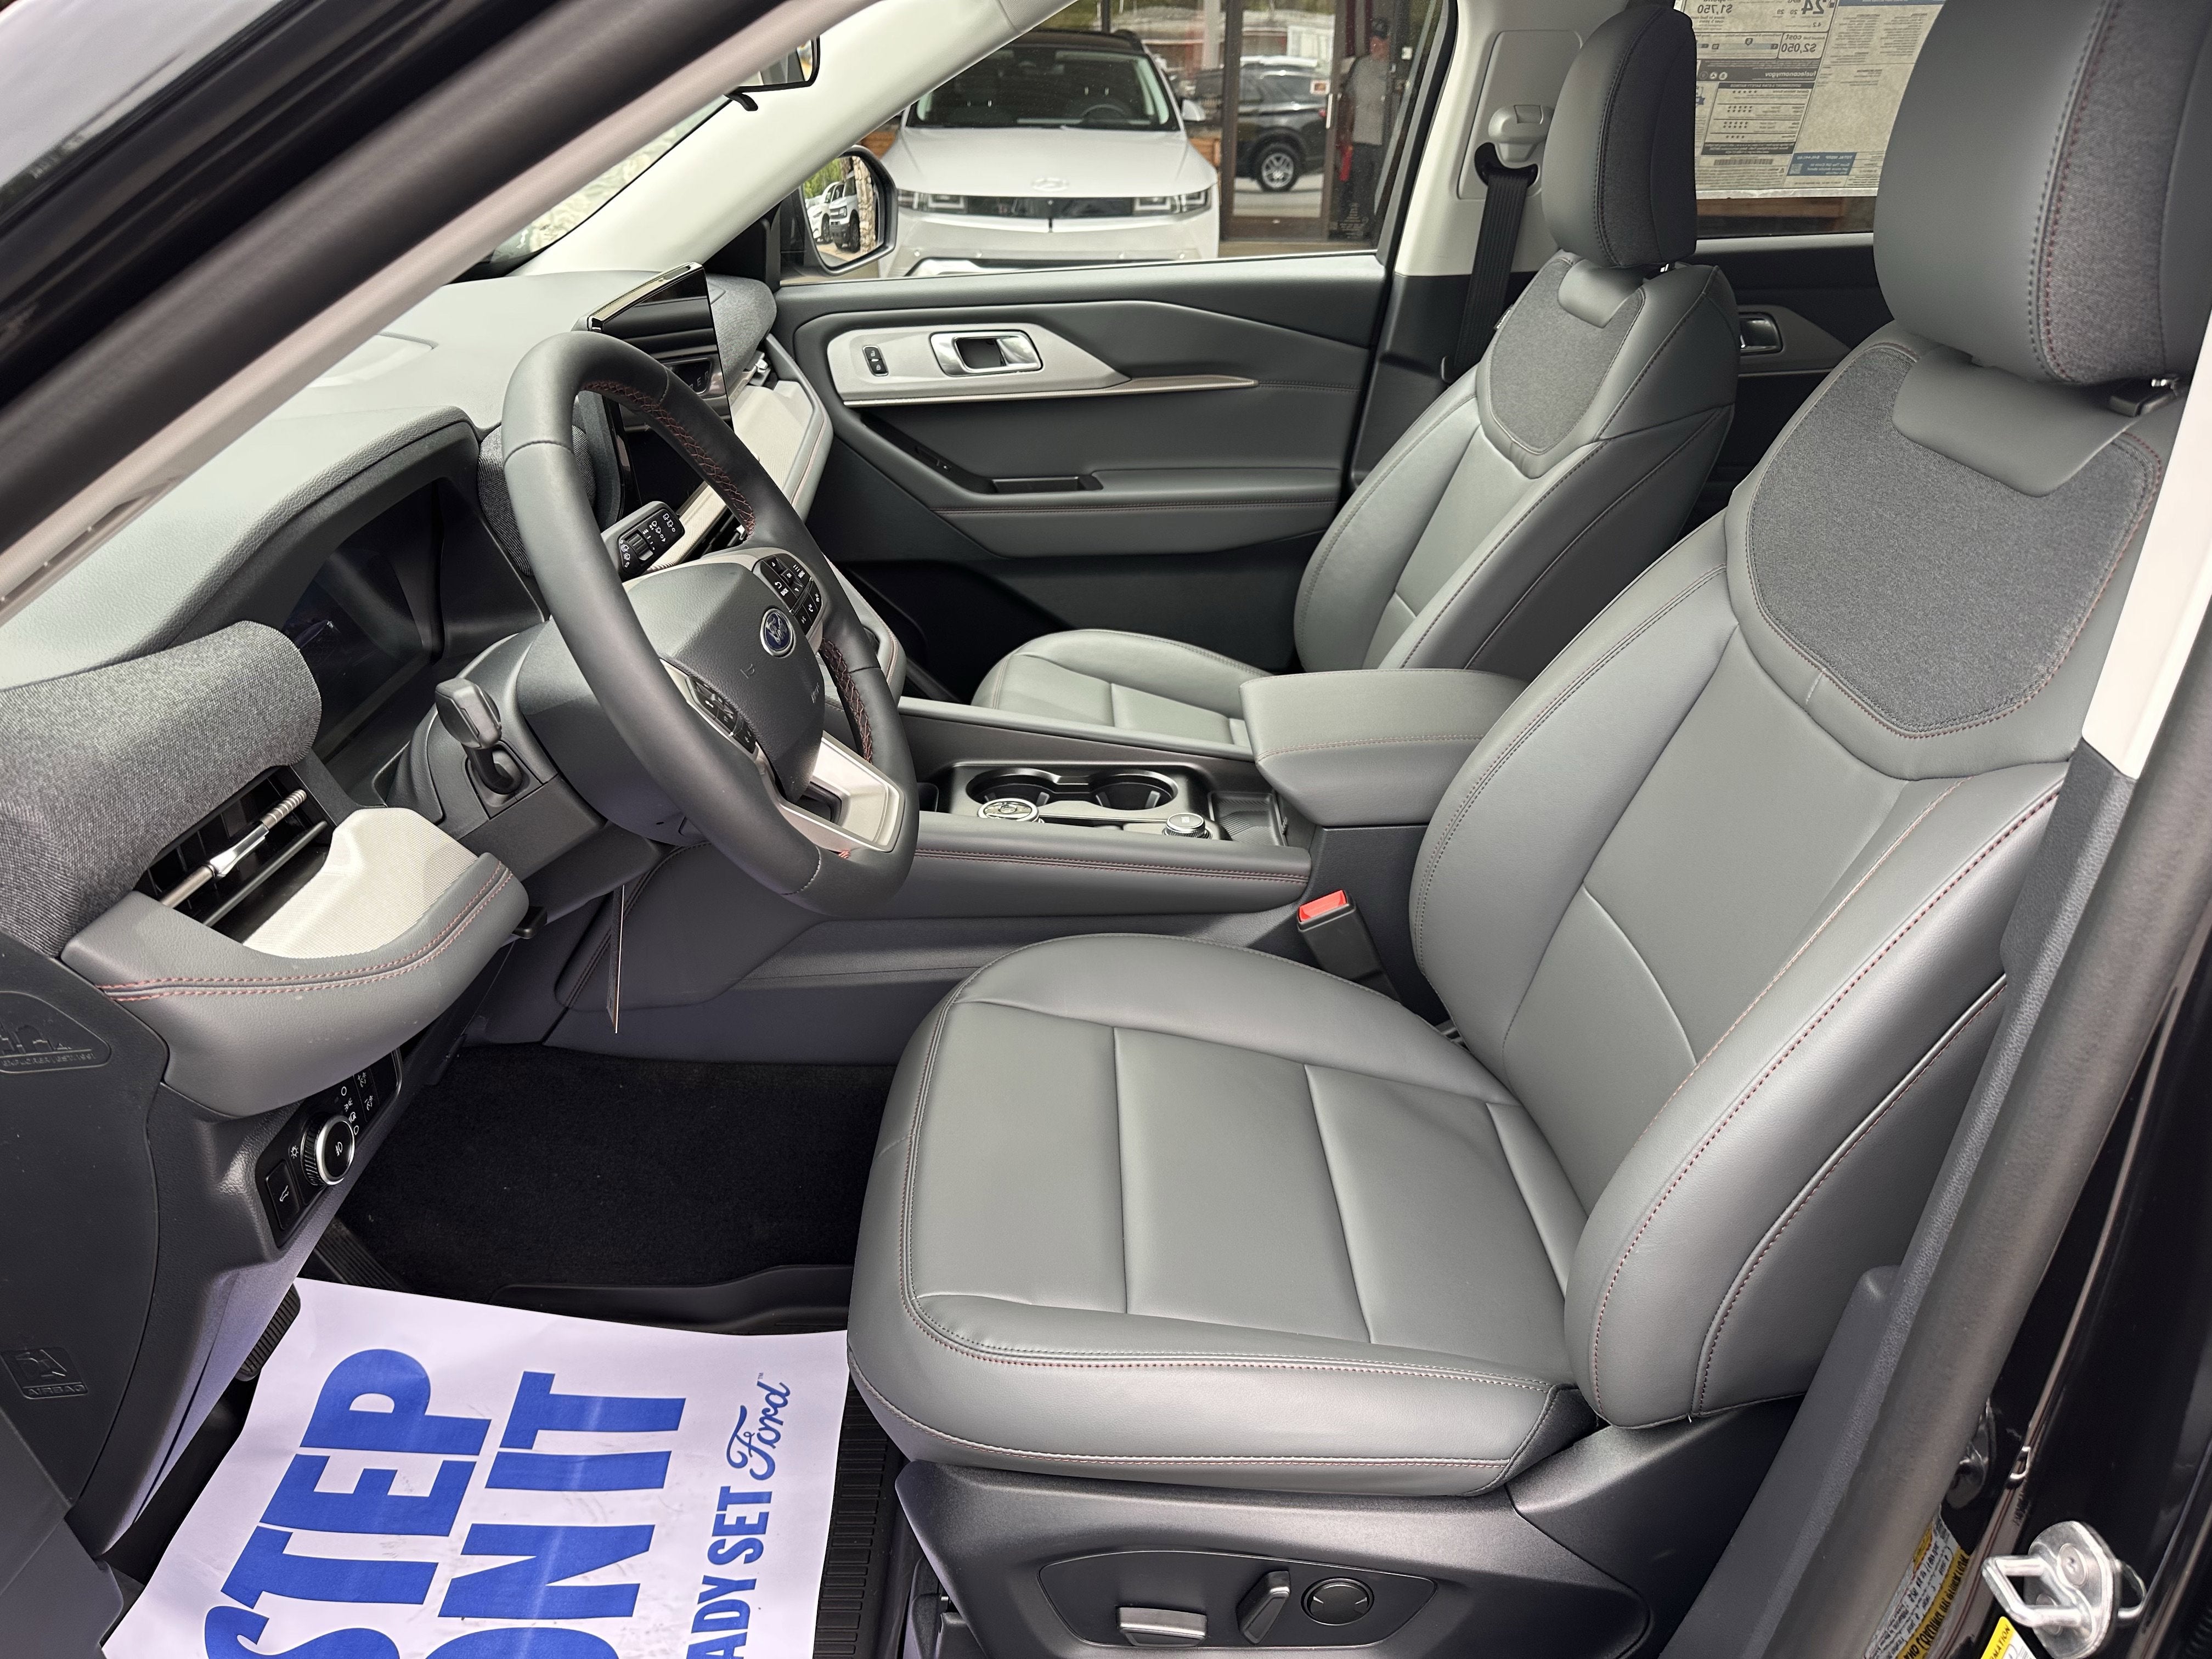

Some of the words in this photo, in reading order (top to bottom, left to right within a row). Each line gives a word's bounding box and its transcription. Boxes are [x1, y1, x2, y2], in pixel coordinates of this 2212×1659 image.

[27, 1384, 85, 1396] AIRBAG
[726, 1380, 791, 1481] Ford
[707, 1486, 772, 1565] SET
